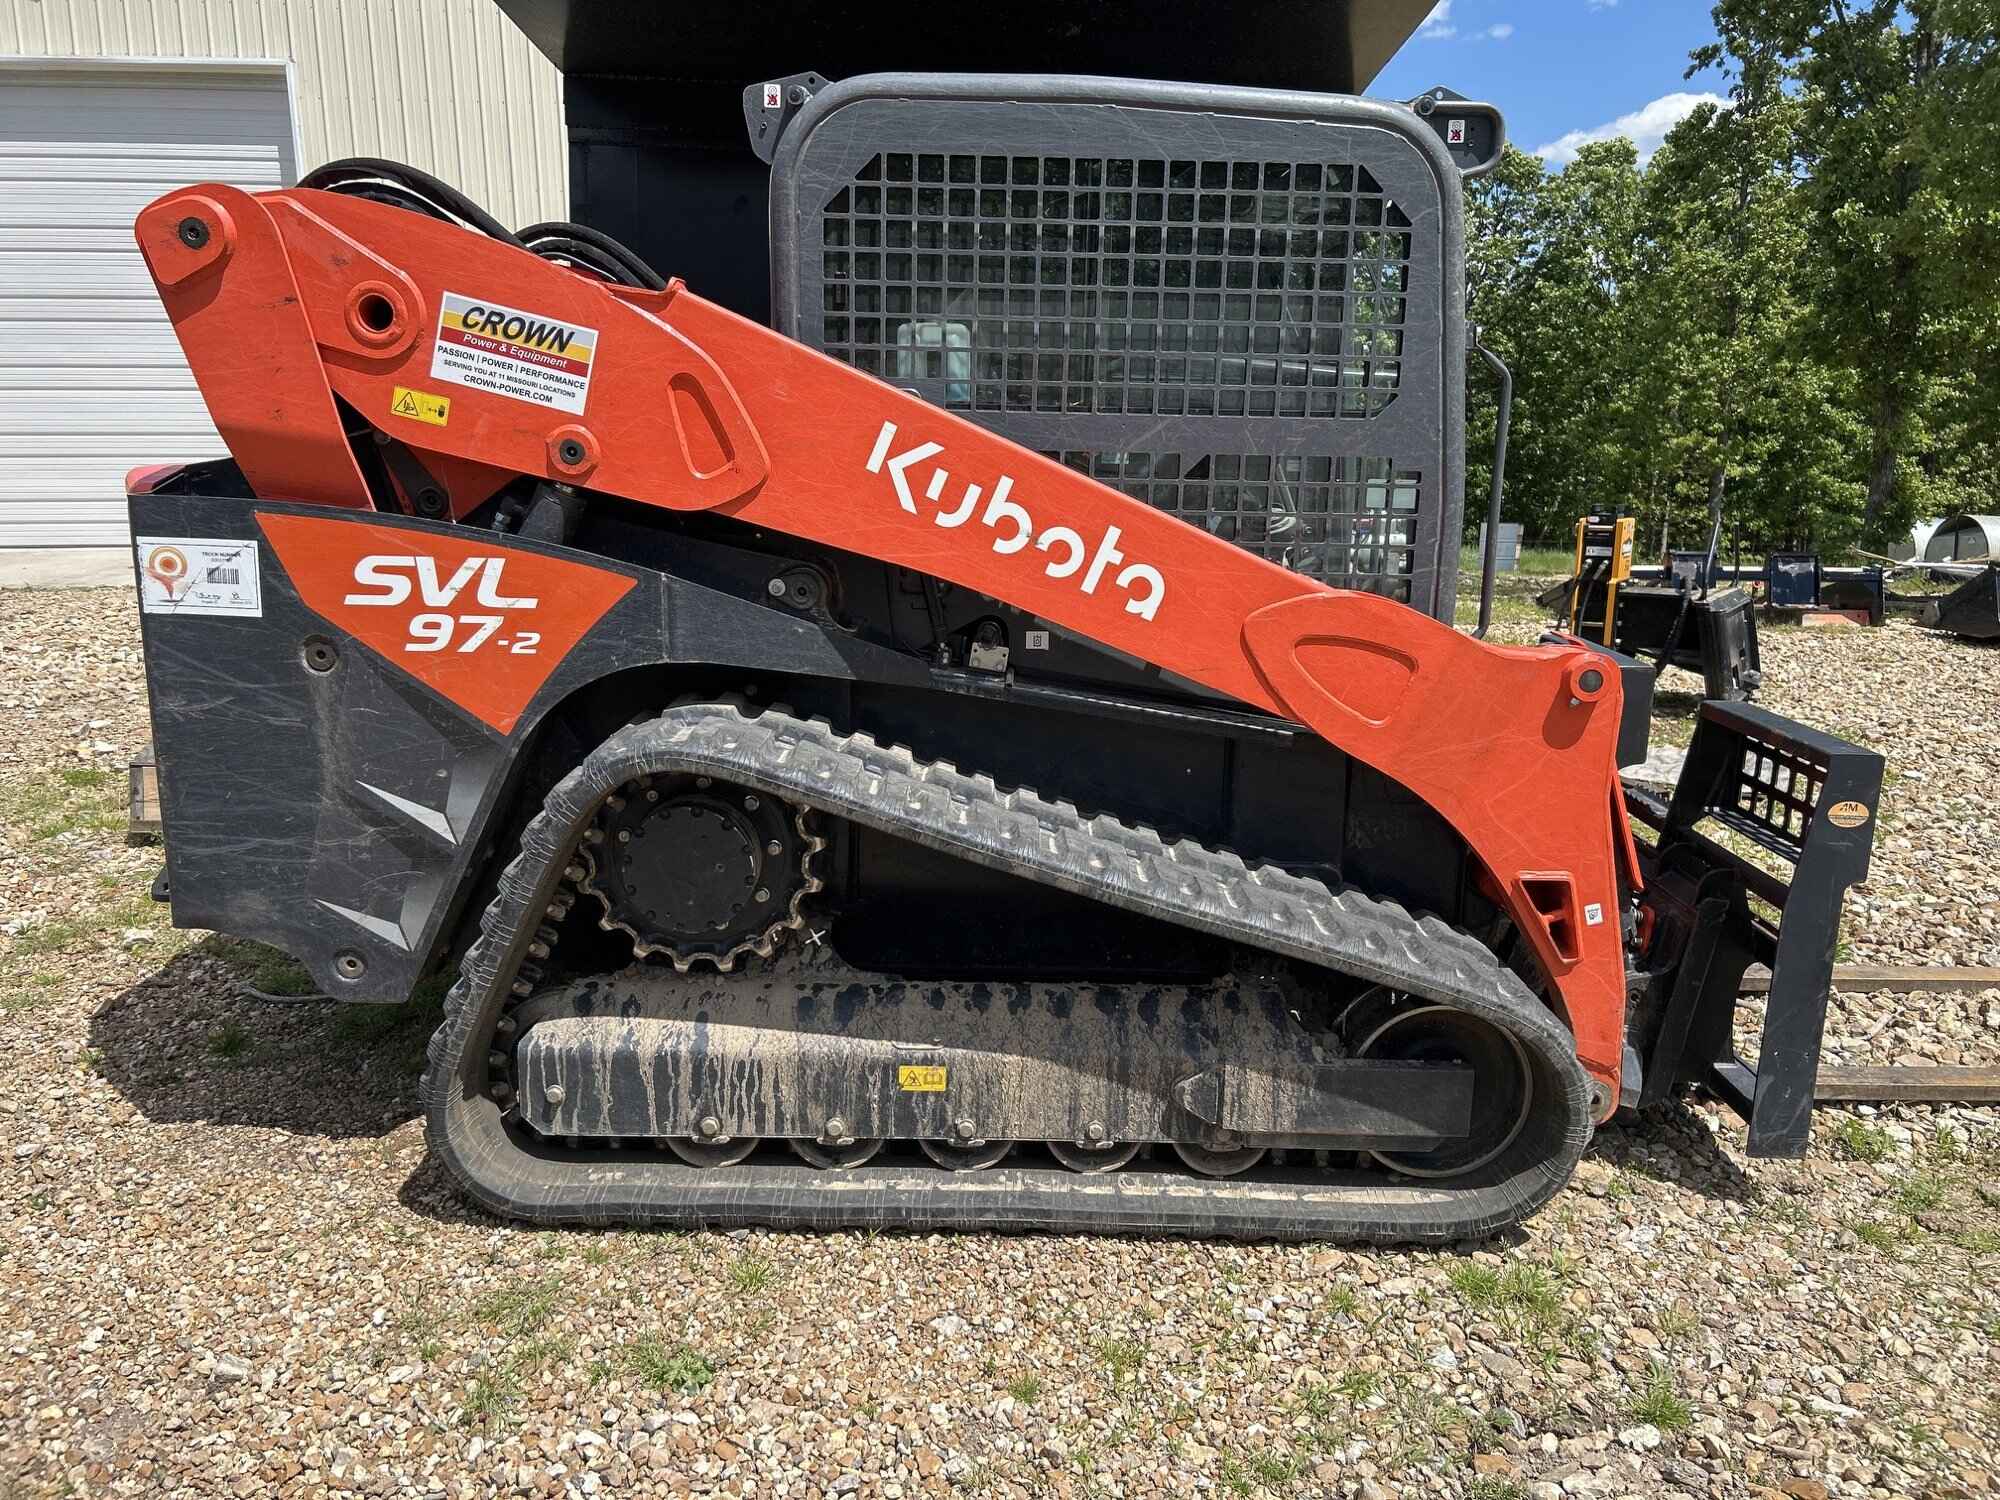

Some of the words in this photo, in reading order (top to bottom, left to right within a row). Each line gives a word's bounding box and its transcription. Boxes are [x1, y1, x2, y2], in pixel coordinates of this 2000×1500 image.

[462, 306, 575, 353] CROWN
[463, 333, 498, 350] Power
[499, 343, 507, 352] &
[510, 346, 568, 369] Equipment
[437, 345, 475, 361] PASSION
[481, 357, 514, 370] POWER
[520, 366, 586, 390] PERFORMANCE
[444, 359, 473, 371] SERVING
[473, 367, 488, 375] YOU
[506, 375, 538, 388] MISSOURI
[539, 384, 576, 398] LOCATIONS
[463, 374, 553, 404] CROWN-POWER.COM
[865, 420, 1166, 622] Kubota
[344, 555, 539, 609] SVL
[404, 613, 541, 654] 97-2
